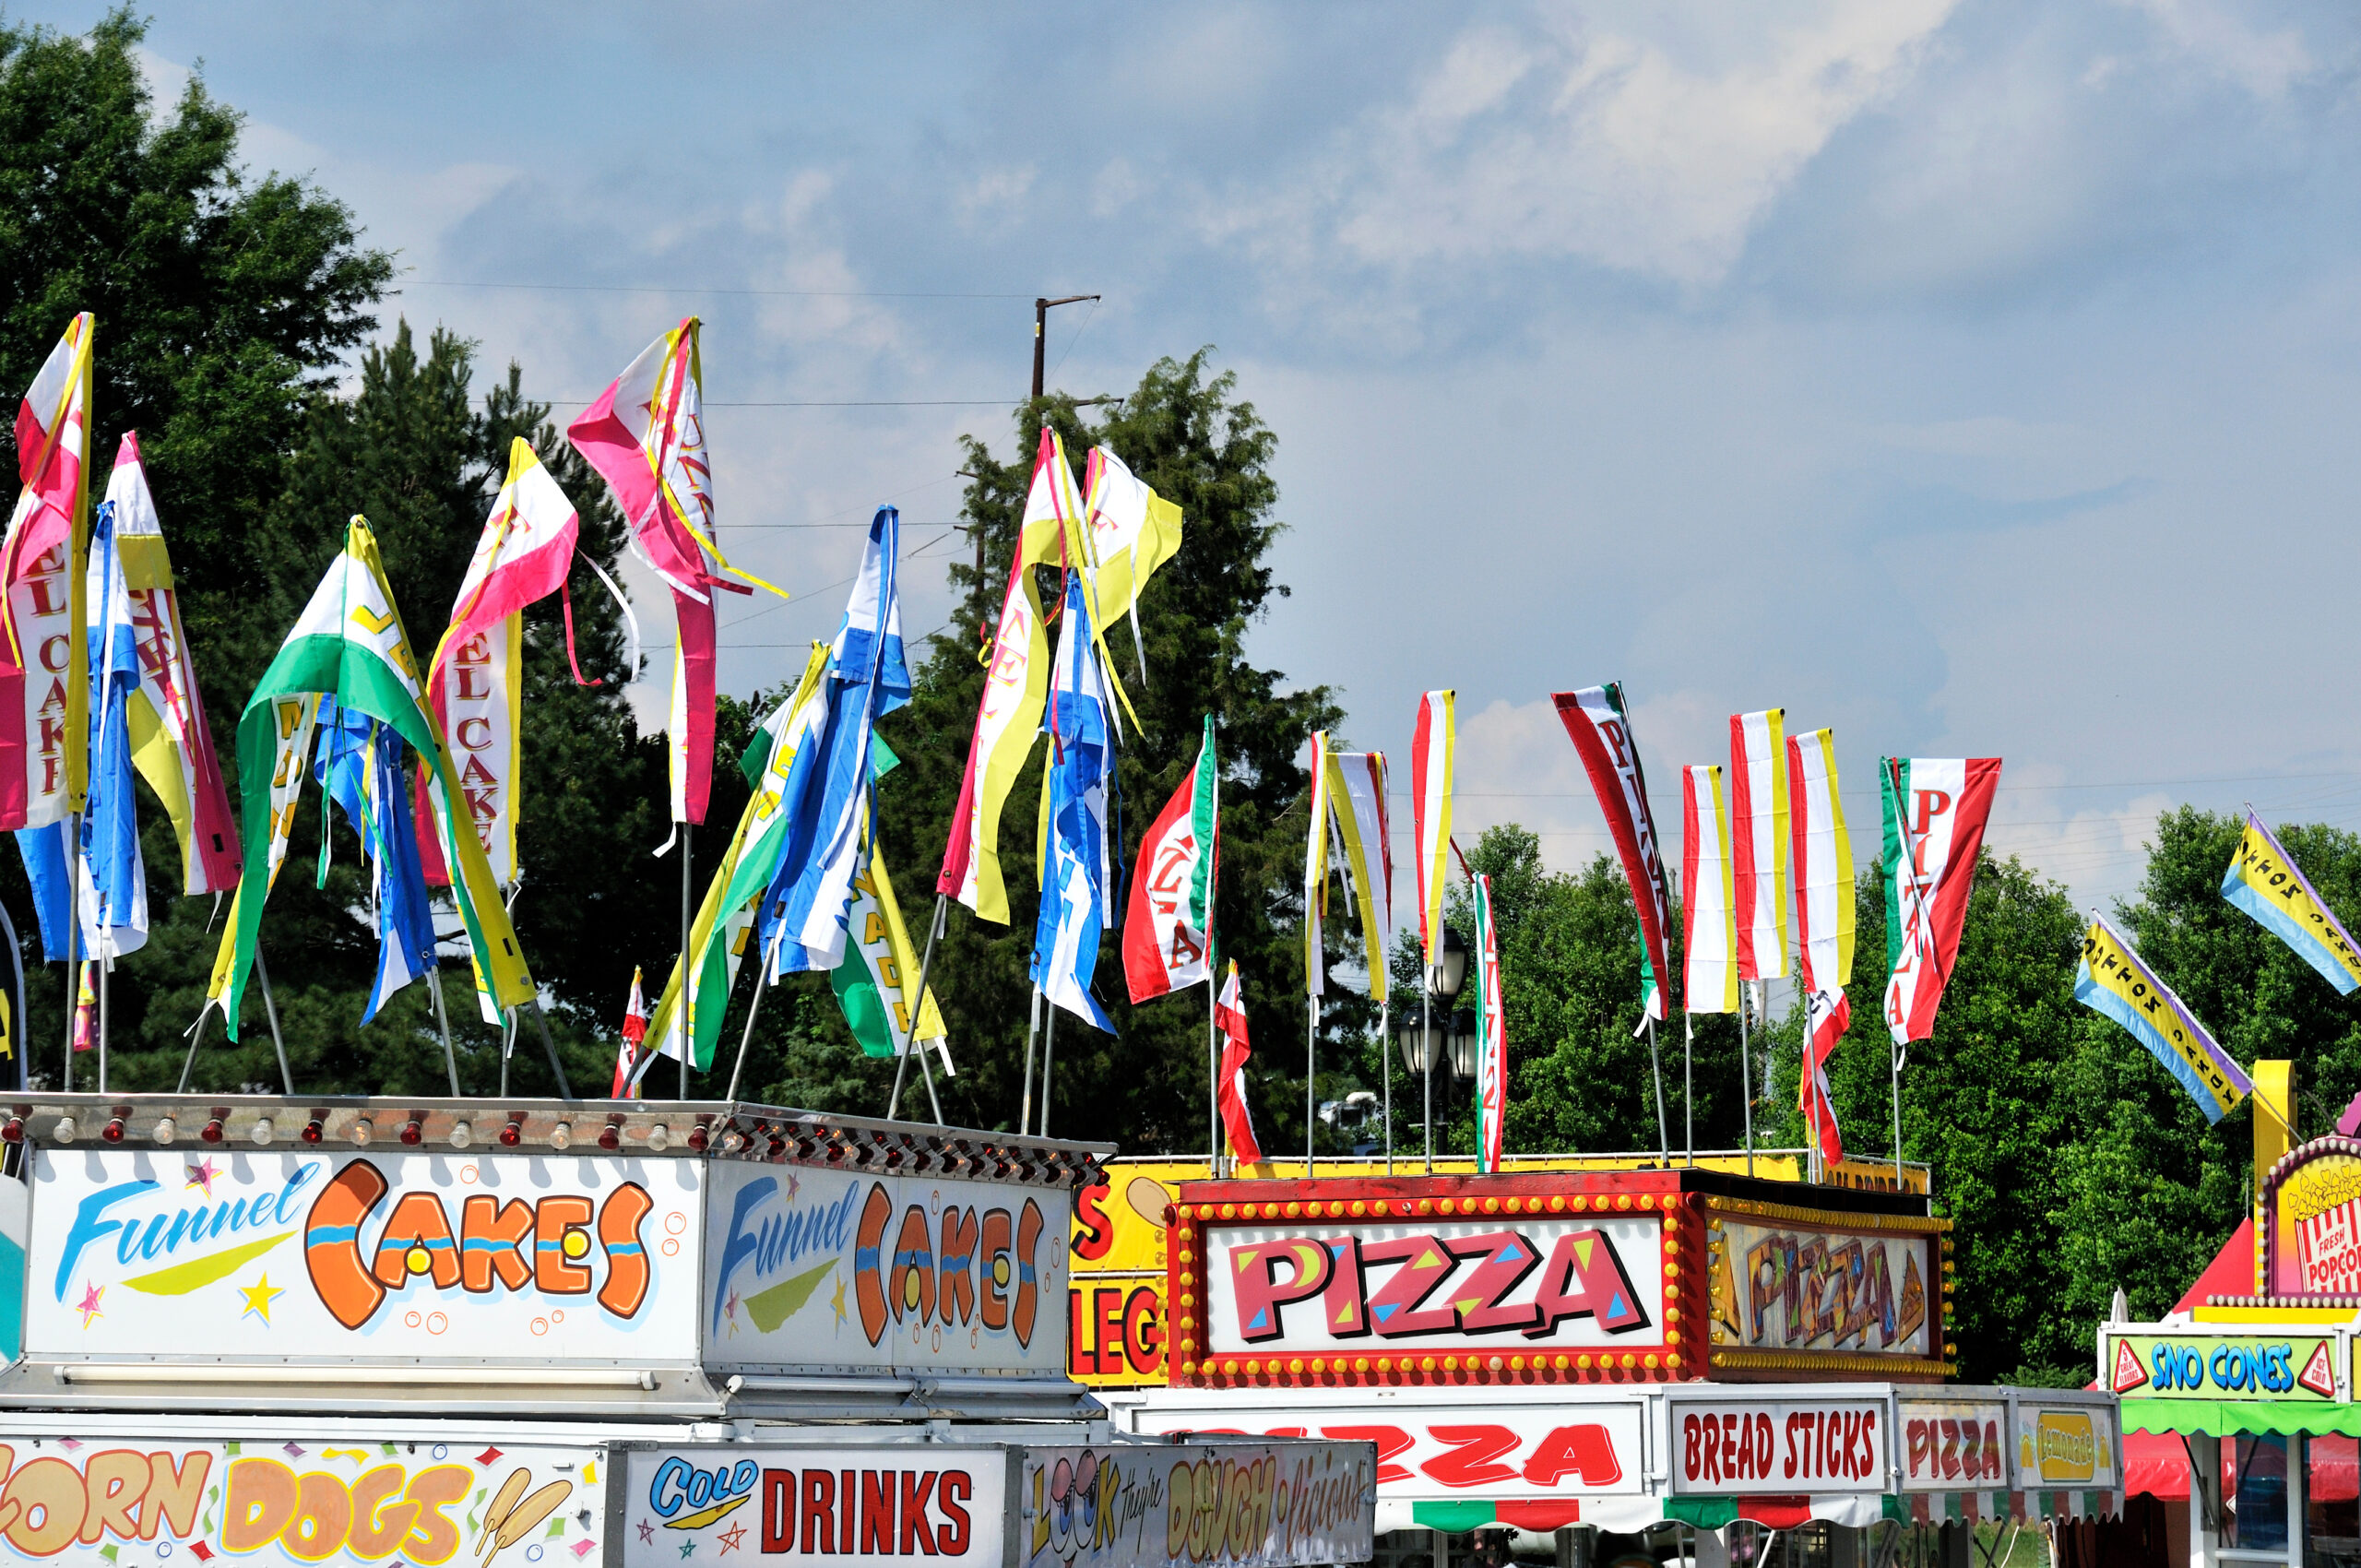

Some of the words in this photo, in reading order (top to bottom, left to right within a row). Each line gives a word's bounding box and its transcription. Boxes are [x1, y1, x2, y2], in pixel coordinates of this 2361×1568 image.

[54, 1162, 320, 1302] Funnel
[304, 1158, 653, 1330] CAKES
[712, 1176, 860, 1338] Funnel
[855, 1181, 1044, 1350] CAKES
[2319, 1227, 2345, 1257] FRESH
[1228, 1229, 1652, 1344] PIZZA
[1747, 1236, 1897, 1348] PIZZA
[1068, 1286, 1169, 1374] LEG
[2120, 1360, 2134, 1373] GREAT
[2151, 1342, 2203, 1391] SNO
[2209, 1342, 2295, 1394] CONES
[2316, 1357, 2325, 1372] ICE
[2312, 1369, 2326, 1385] COLD
[1684, 1413, 1774, 1485] BREAD
[1785, 1410, 1875, 1482] STICKS
[1906, 1419, 2001, 1480] PIZZA
[2039, 1423, 2093, 1465] Lemonade
[0, 1443, 212, 1557] ORN
[222, 1457, 474, 1565] DOGS
[761, 1468, 971, 1556] DRINKS
[1032, 1449, 1121, 1560] LOOK
